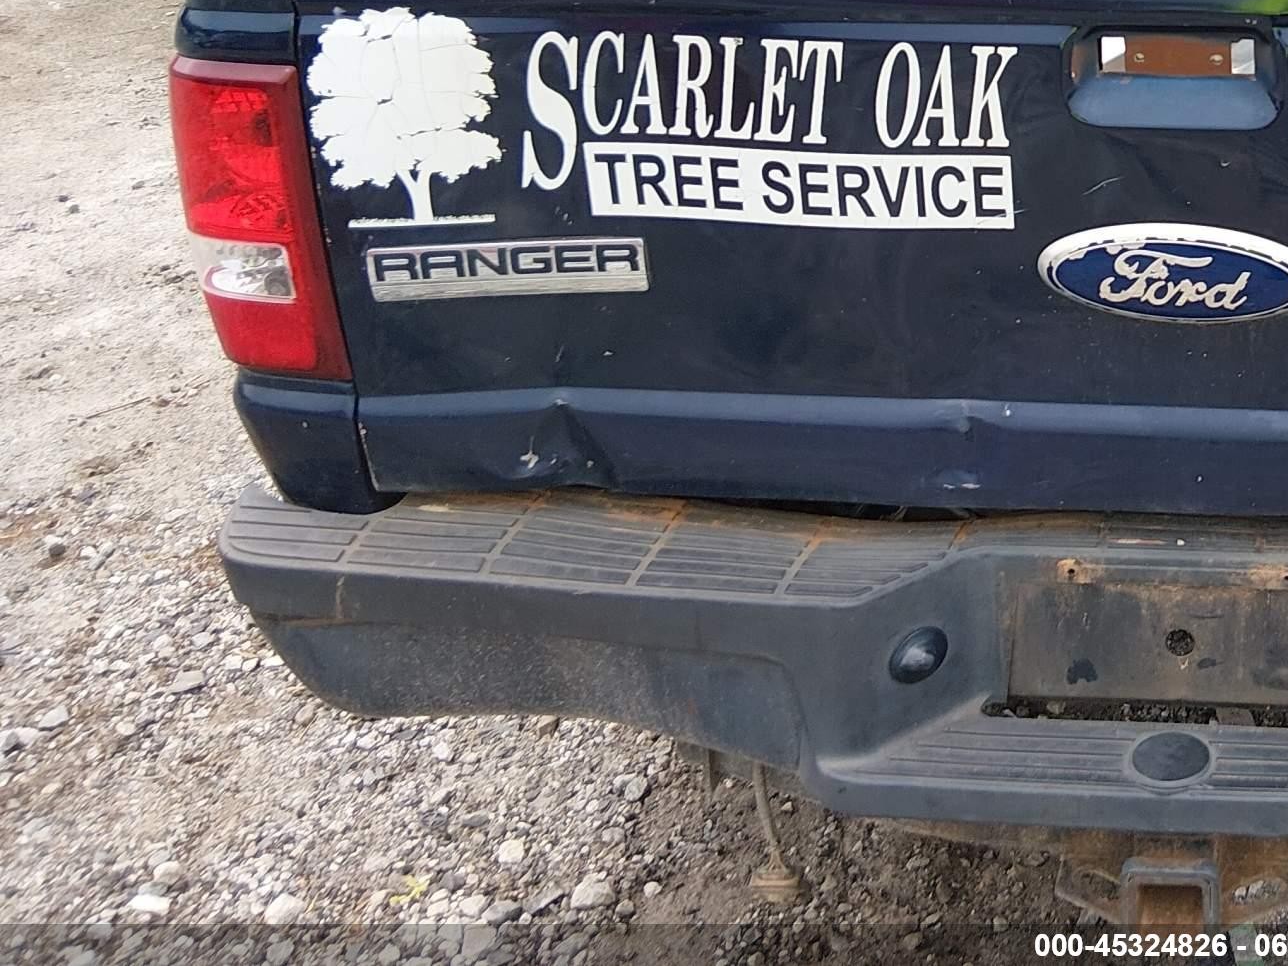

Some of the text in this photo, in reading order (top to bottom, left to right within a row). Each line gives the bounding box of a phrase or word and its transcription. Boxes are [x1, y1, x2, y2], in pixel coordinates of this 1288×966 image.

[522, 31, 1018, 190] SCARLET OAK
[595, 153, 1007, 218] TREE SERVICE
[372, 244, 641, 283] RANGER
[1100, 248, 1251, 311] Ford
